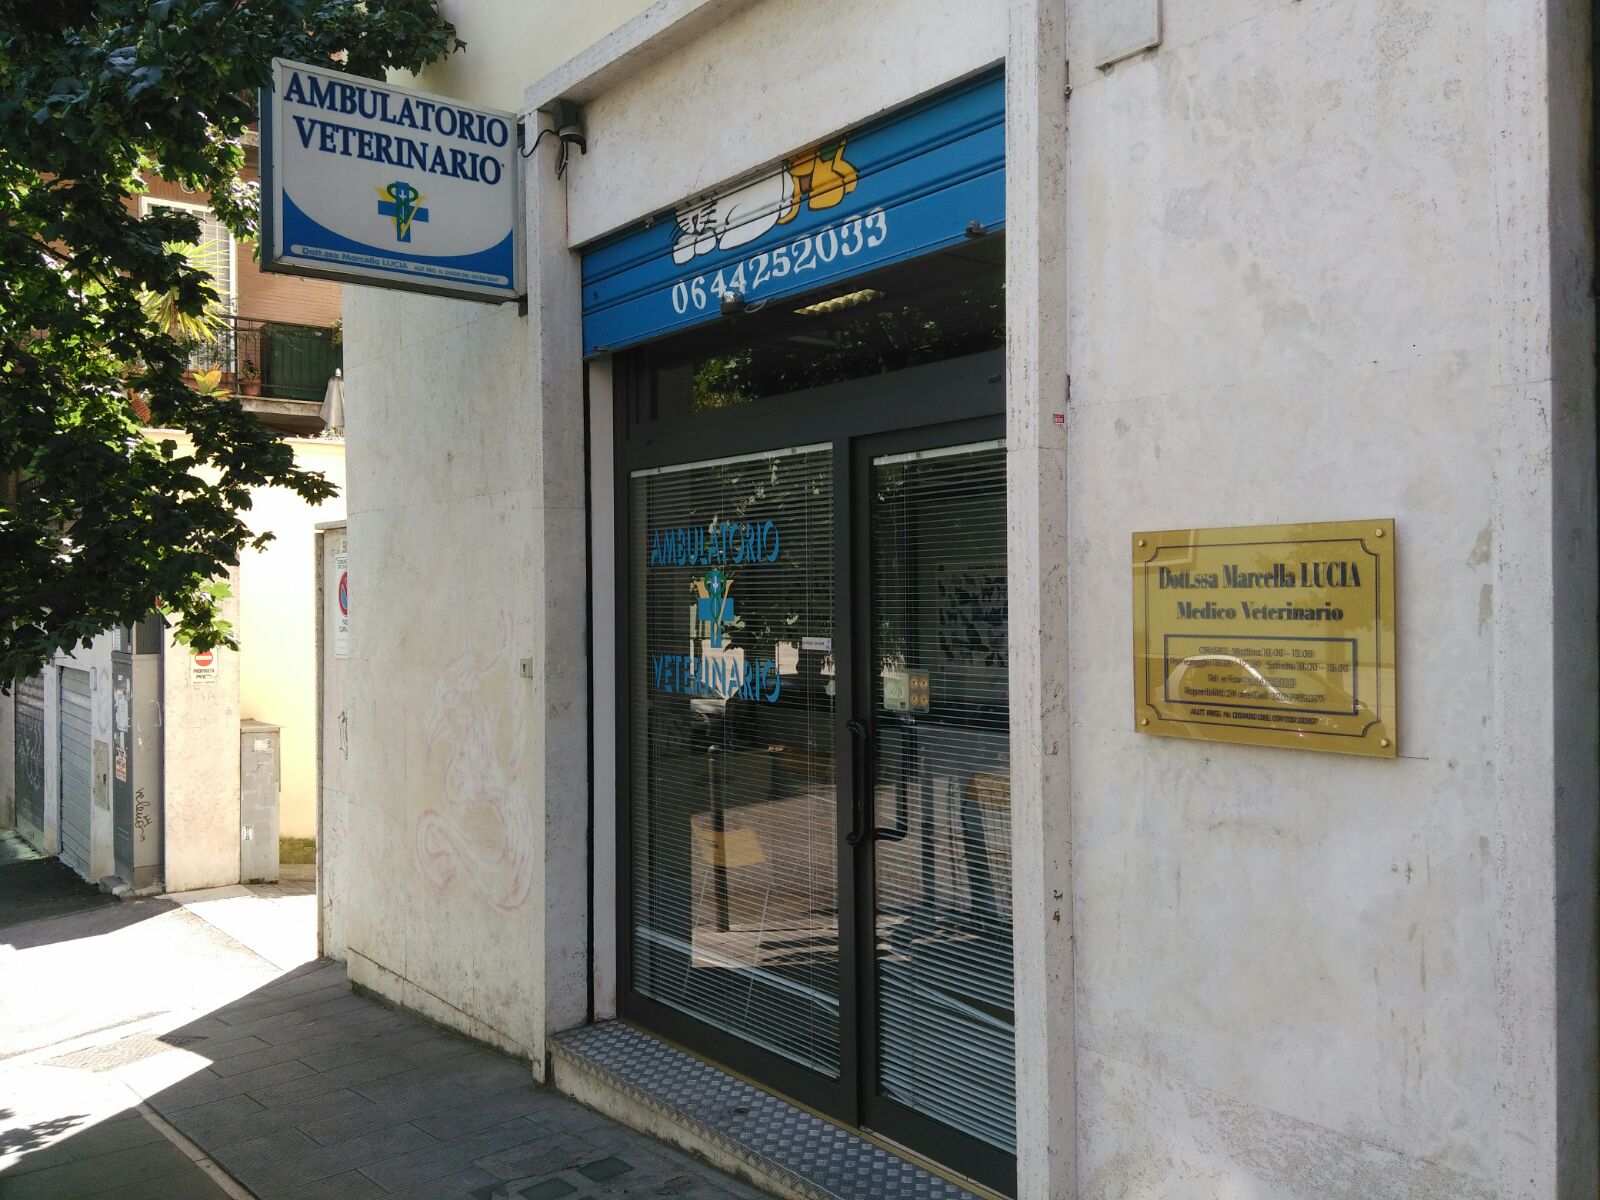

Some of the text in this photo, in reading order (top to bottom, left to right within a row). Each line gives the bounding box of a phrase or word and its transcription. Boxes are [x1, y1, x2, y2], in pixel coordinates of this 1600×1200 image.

[284, 72, 509, 147] AMBULATORIO
[293, 115, 502, 185] VETERINARIO
[382, 259, 409, 269] LUCIA
[672, 207, 888, 314] 0644252033
[650, 520, 780, 567] AMBULATORIO
[1158, 561, 1362, 590] Dott.ssa Marcella LUCIA
[1176, 601, 1344, 621] Medico Veterinario
[652, 653, 781, 703] VETERINARIO
